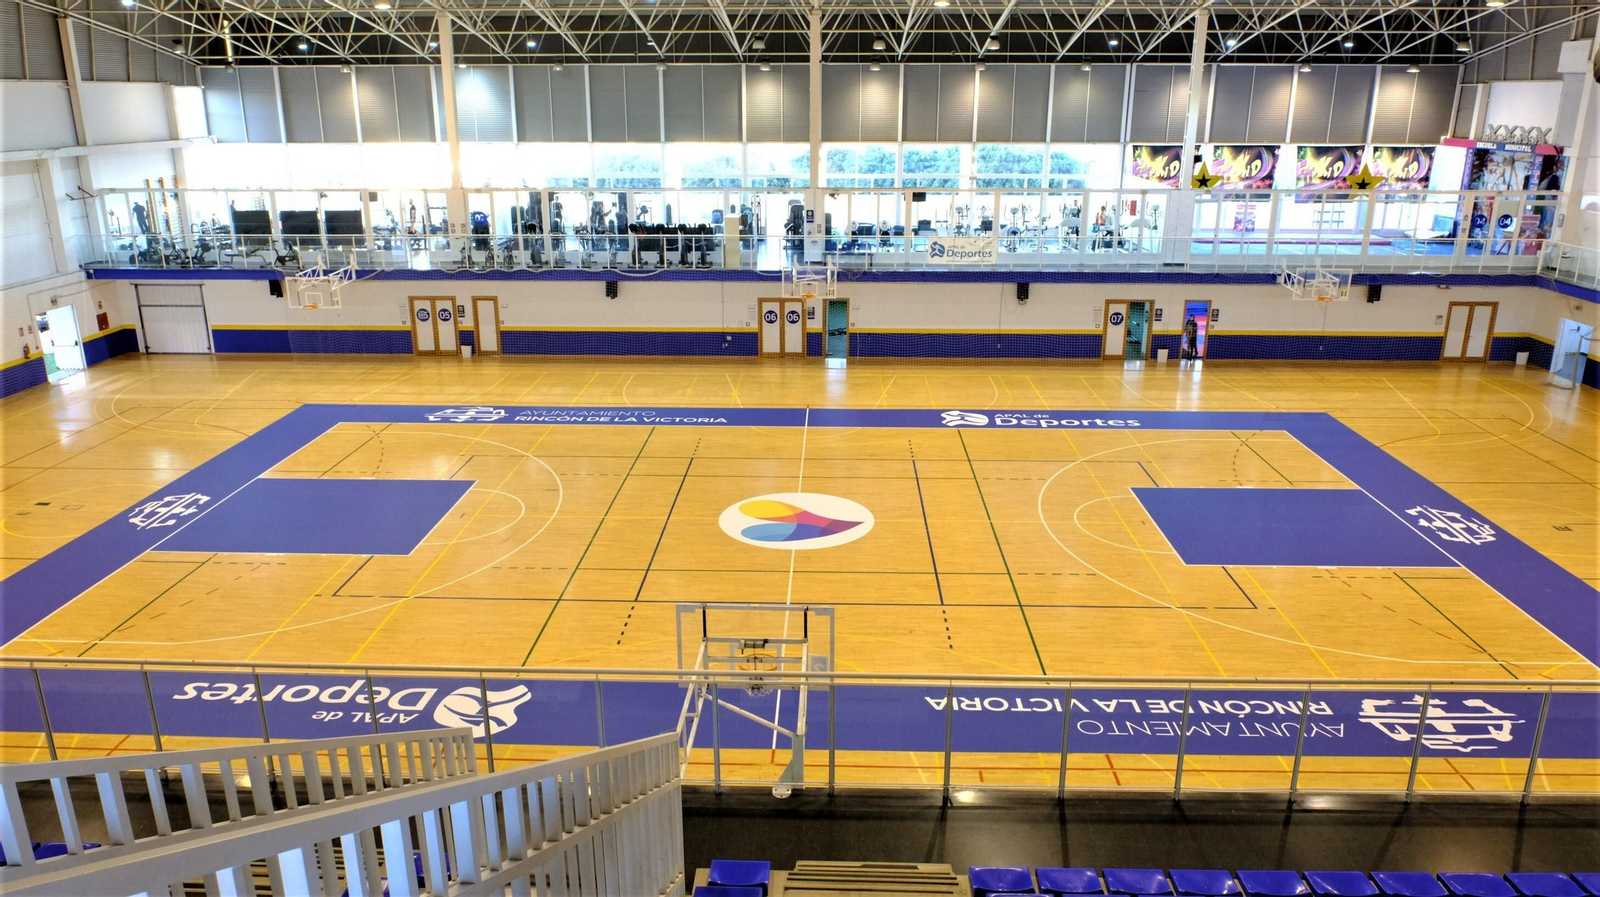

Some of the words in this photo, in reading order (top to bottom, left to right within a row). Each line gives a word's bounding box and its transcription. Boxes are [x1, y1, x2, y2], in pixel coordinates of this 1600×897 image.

[1476, 141, 1497, 150] ESCUELA
[1504, 143, 1532, 153] MUNICIPAL
[1499, 216, 1512, 226] 04
[946, 249, 993, 260] Deportes
[439, 311, 451, 319] 05
[765, 313, 777, 321] 06
[787, 313, 799, 321] 06
[1111, 314, 1122, 323] 07
[994, 417, 1141, 428] Deportes
[172, 679, 438, 711] Deportes
[924, 696, 1090, 712] VICTORIA
[1091, 698, 1141, 712] LA
[1145, 700, 1195, 714] DE
[311, 710, 343, 722] de
[351, 712, 420, 724] APAL
[1077, 720, 1344, 738] AYUNTAMIENTO
